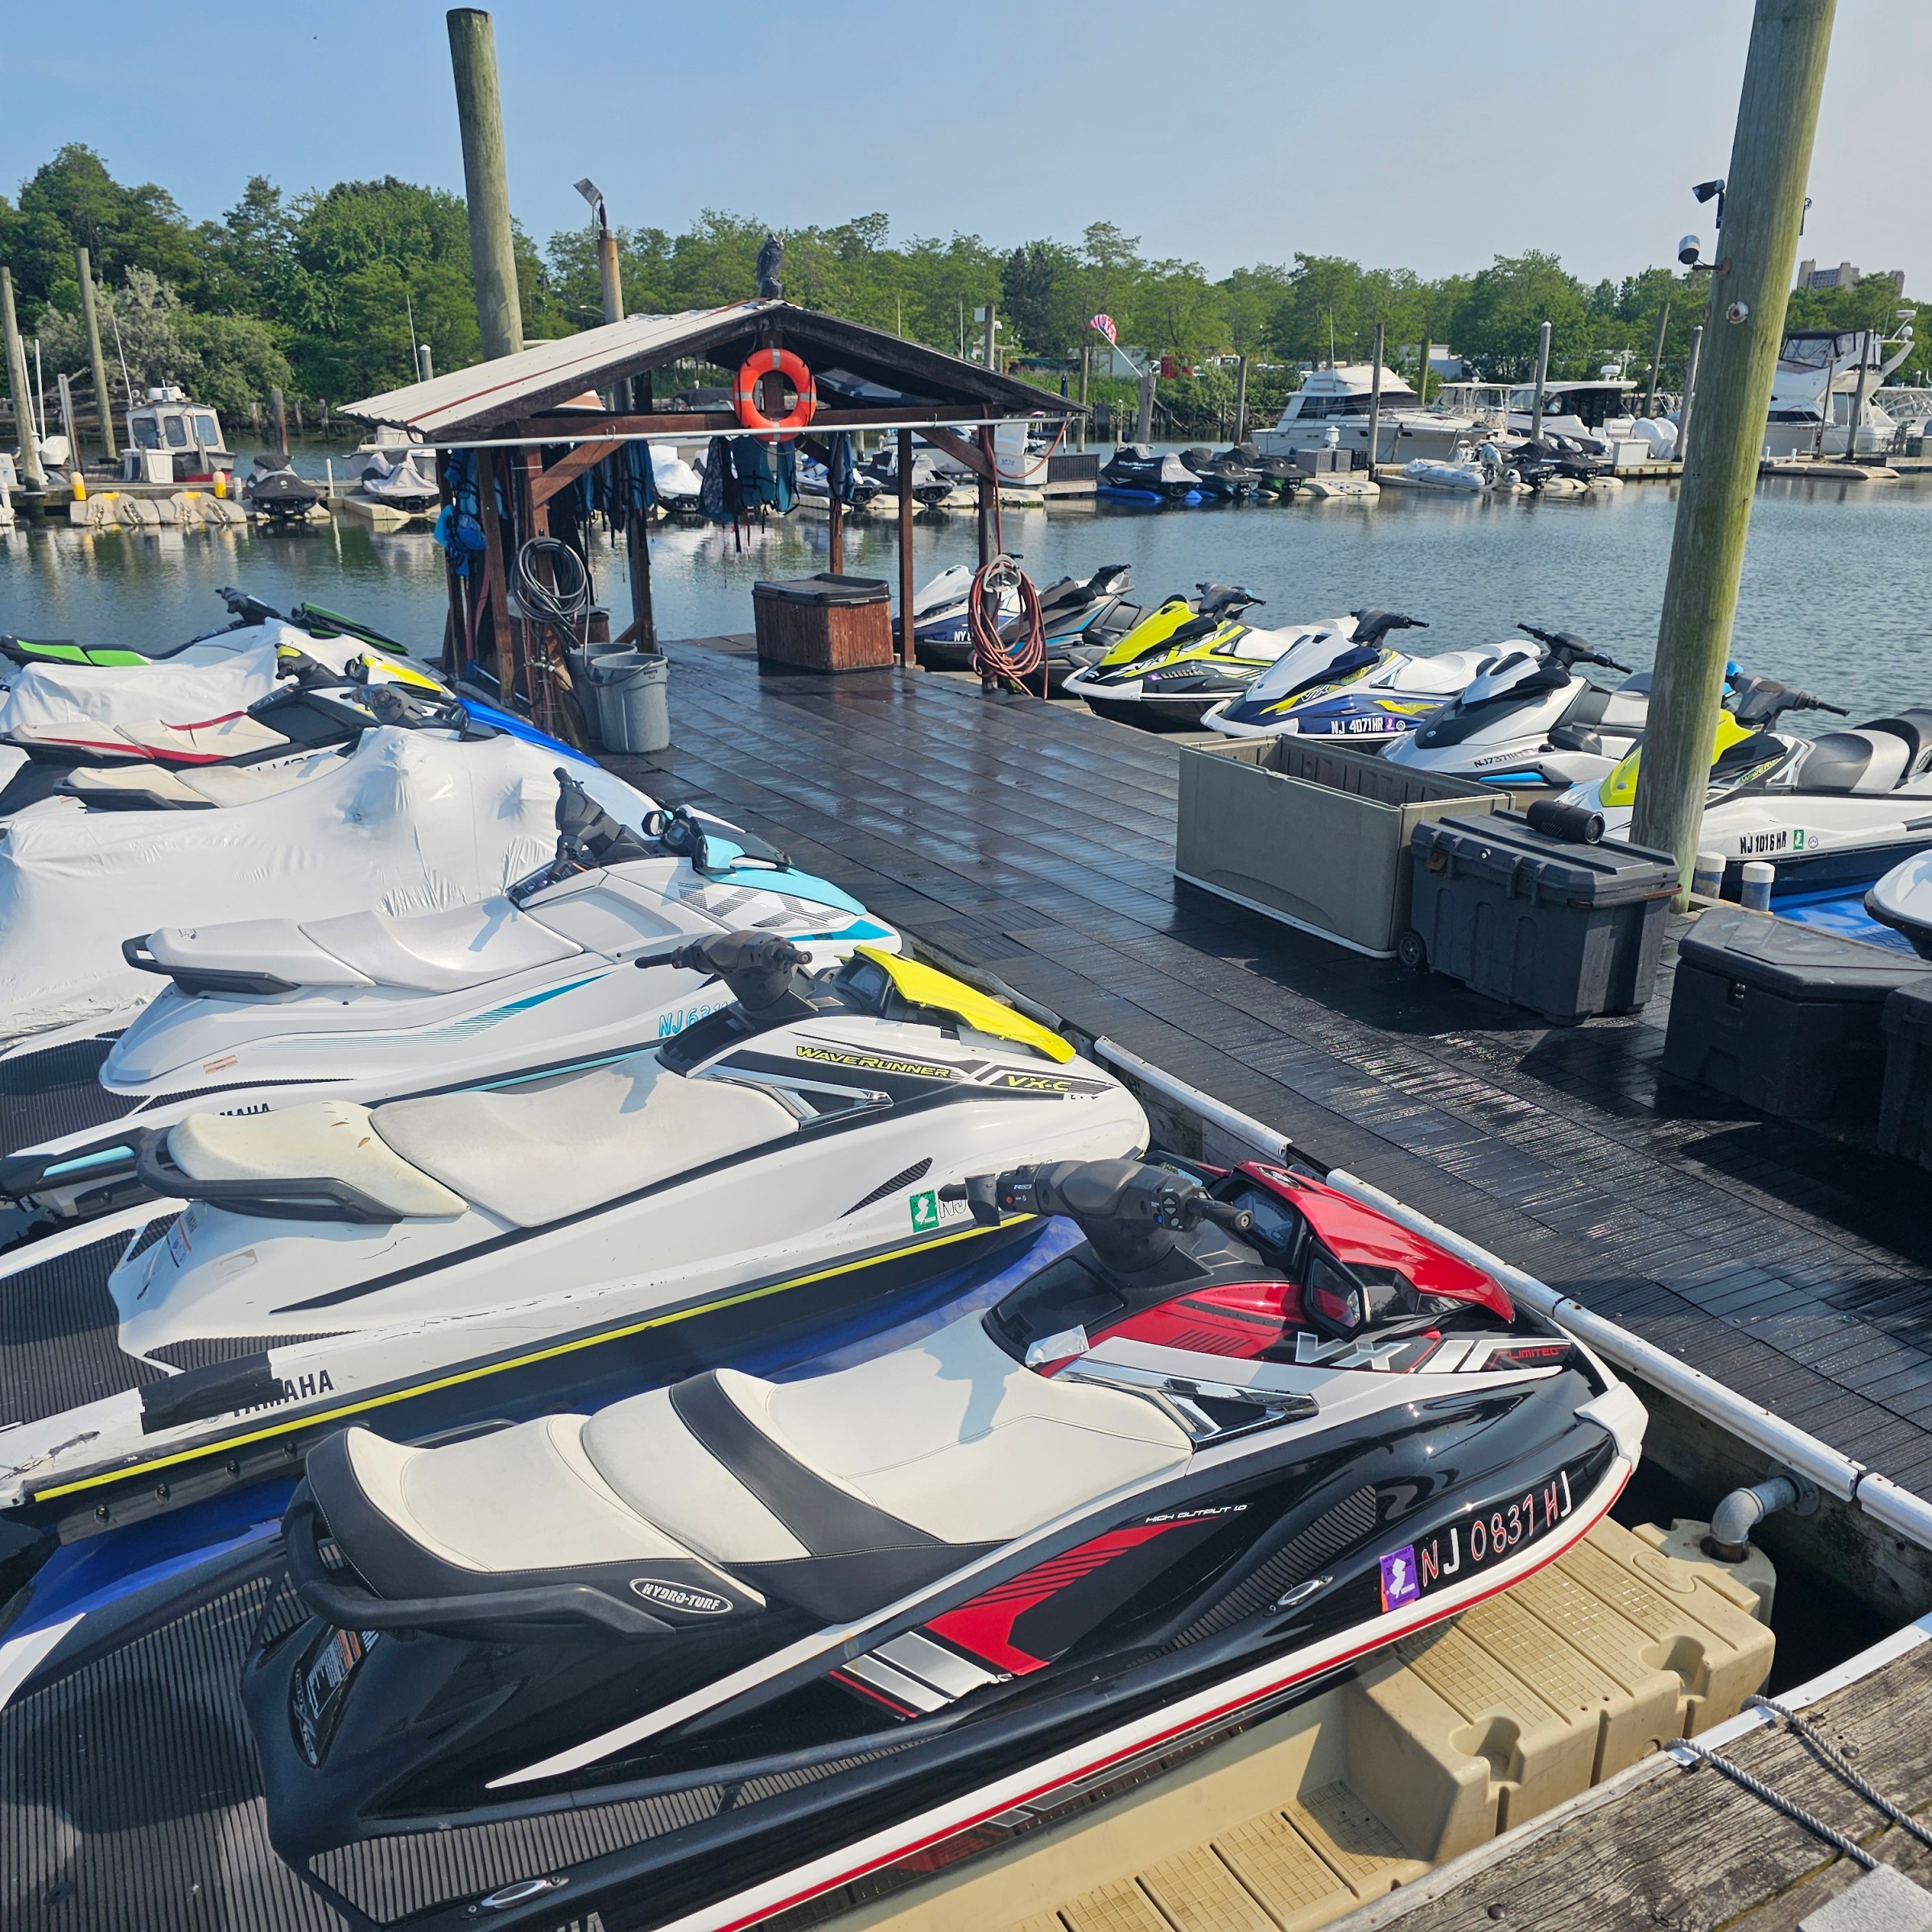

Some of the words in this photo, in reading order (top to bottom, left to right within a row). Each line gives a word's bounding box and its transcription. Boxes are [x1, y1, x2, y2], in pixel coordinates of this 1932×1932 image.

[954, 630, 967, 642] NY
[1331, 720, 1346, 735] NJ
[1740, 836, 1753, 854] NJ
[658, 1009, 683, 1038] NJ
[939, 1198, 967, 1220] NJ
[1507, 1348, 1559, 1360] LIMITED
[1146, 1513, 1174, 1523] HIGH
[1177, 1505, 1232, 1519] OUTPUT
[1422, 1527, 1461, 1588] NJ
[1543, 1470, 1572, 1528] HJ
[642, 1583, 720, 1611] HYDRO-TURF
